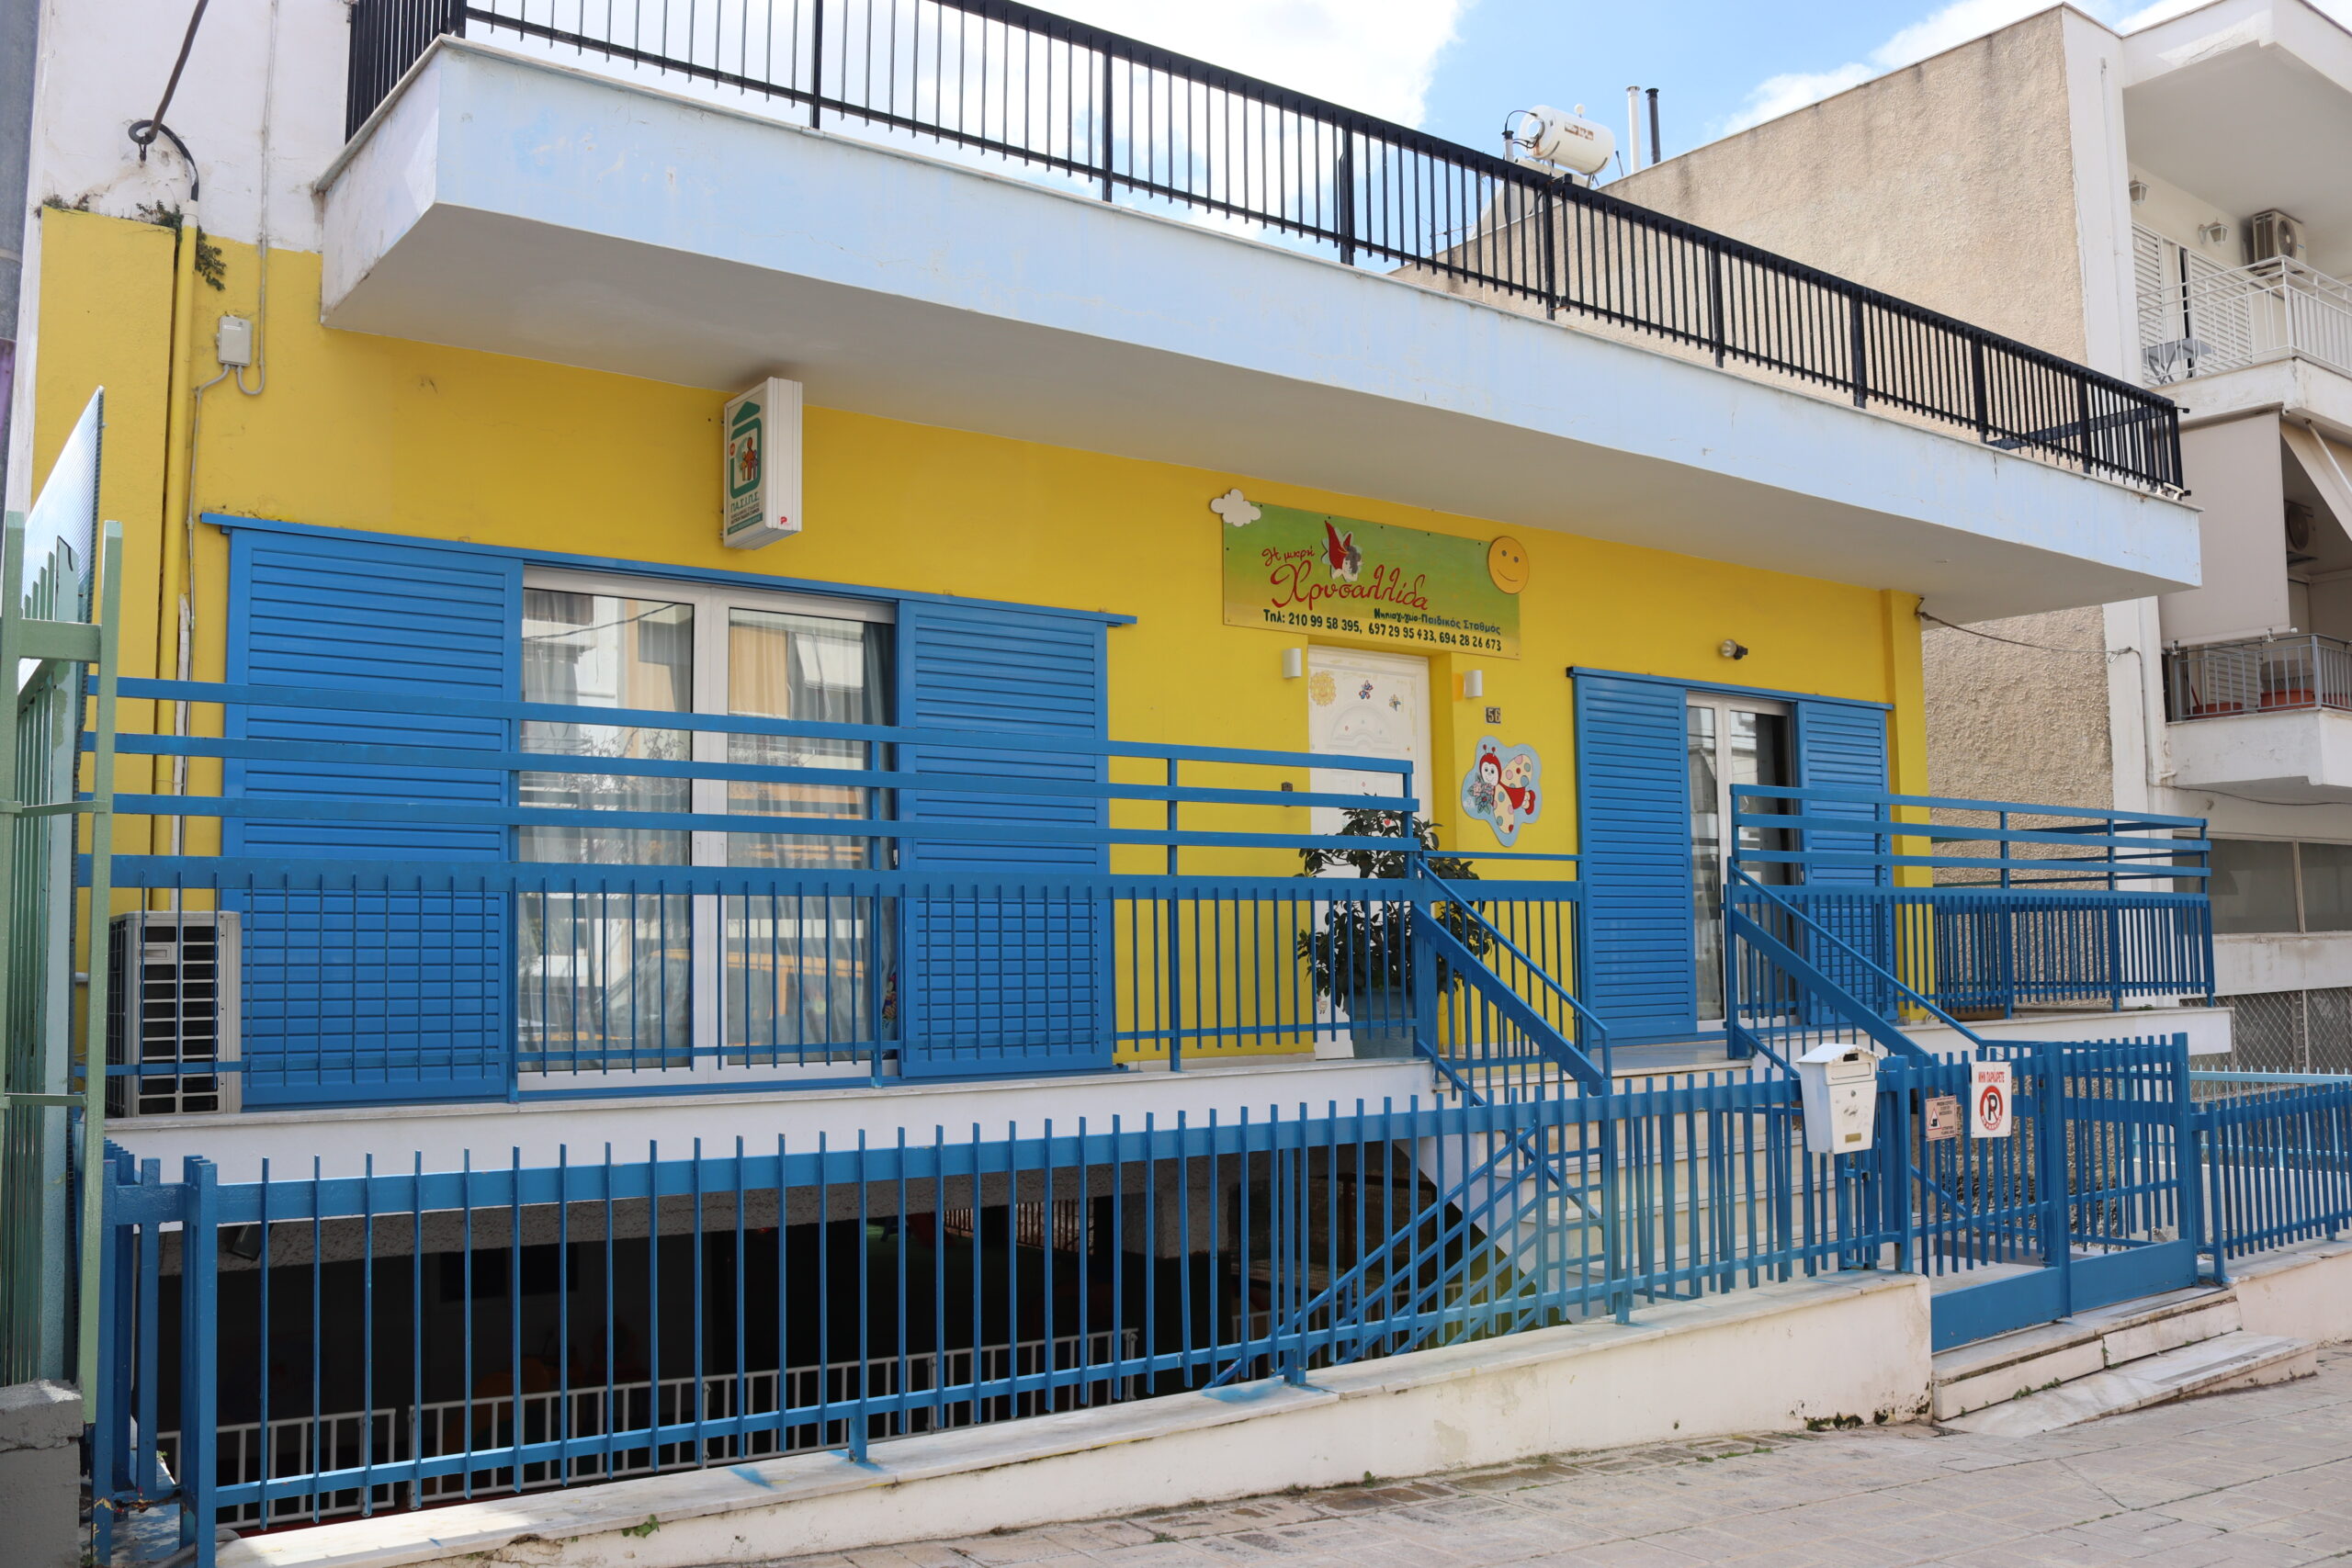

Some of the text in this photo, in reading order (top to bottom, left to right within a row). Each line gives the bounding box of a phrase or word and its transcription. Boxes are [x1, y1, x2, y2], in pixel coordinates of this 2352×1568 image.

[1284, 546, 1316, 562] μικρή
[1270, 559, 1429, 611] Χρυσαλλίδα
[1263, 608, 1502, 652] Τηλ: 210 99 58 395, 697 29 95 433, 694 28 26 673
[1463, 619, 1501, 636] Σταθμός
[1487, 708, 1500, 722] 56
